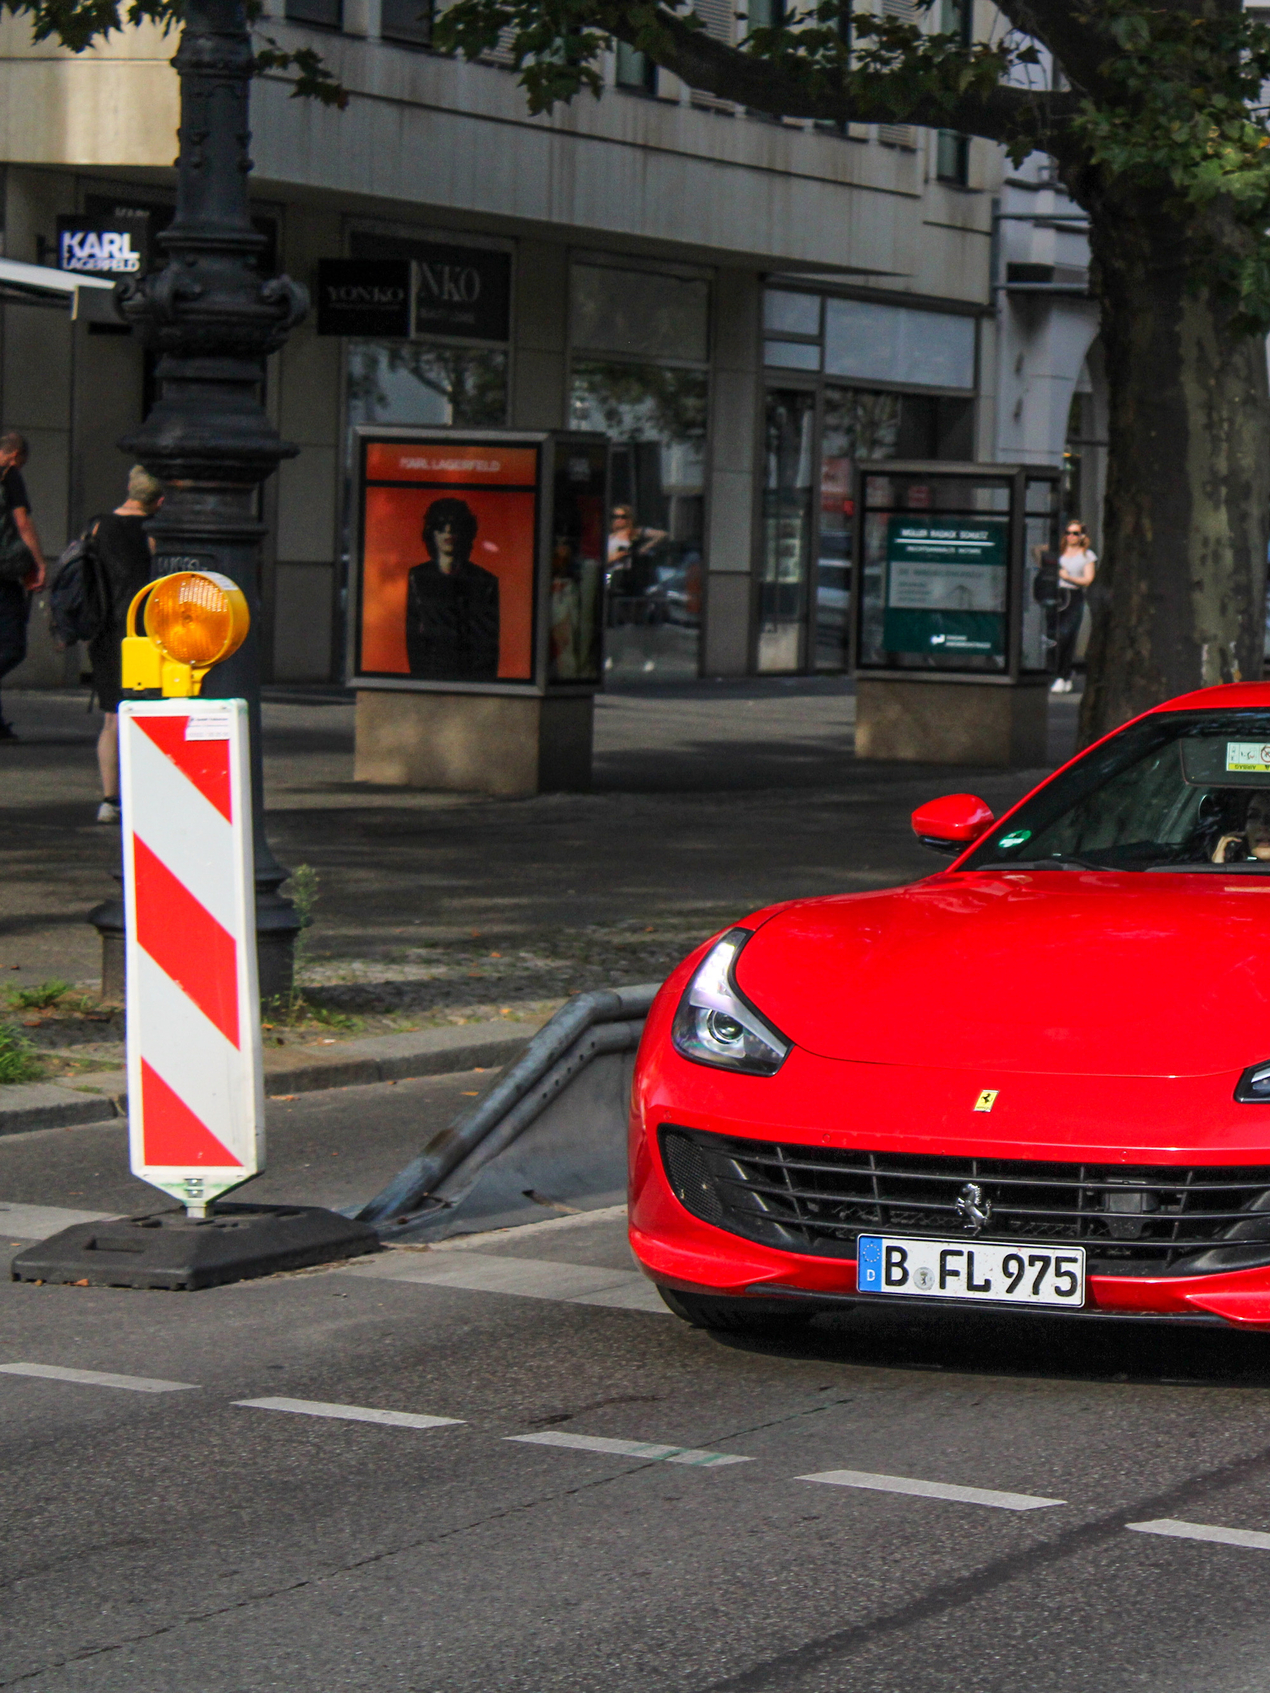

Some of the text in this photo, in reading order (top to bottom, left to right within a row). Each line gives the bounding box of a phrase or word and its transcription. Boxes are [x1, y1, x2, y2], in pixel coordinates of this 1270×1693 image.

[62, 231, 140, 259] KARL
[63, 258, 140, 272] LAGERFELD
[866, 1269, 876, 1281] D
[885, 1245, 1079, 1297] B FL 975
